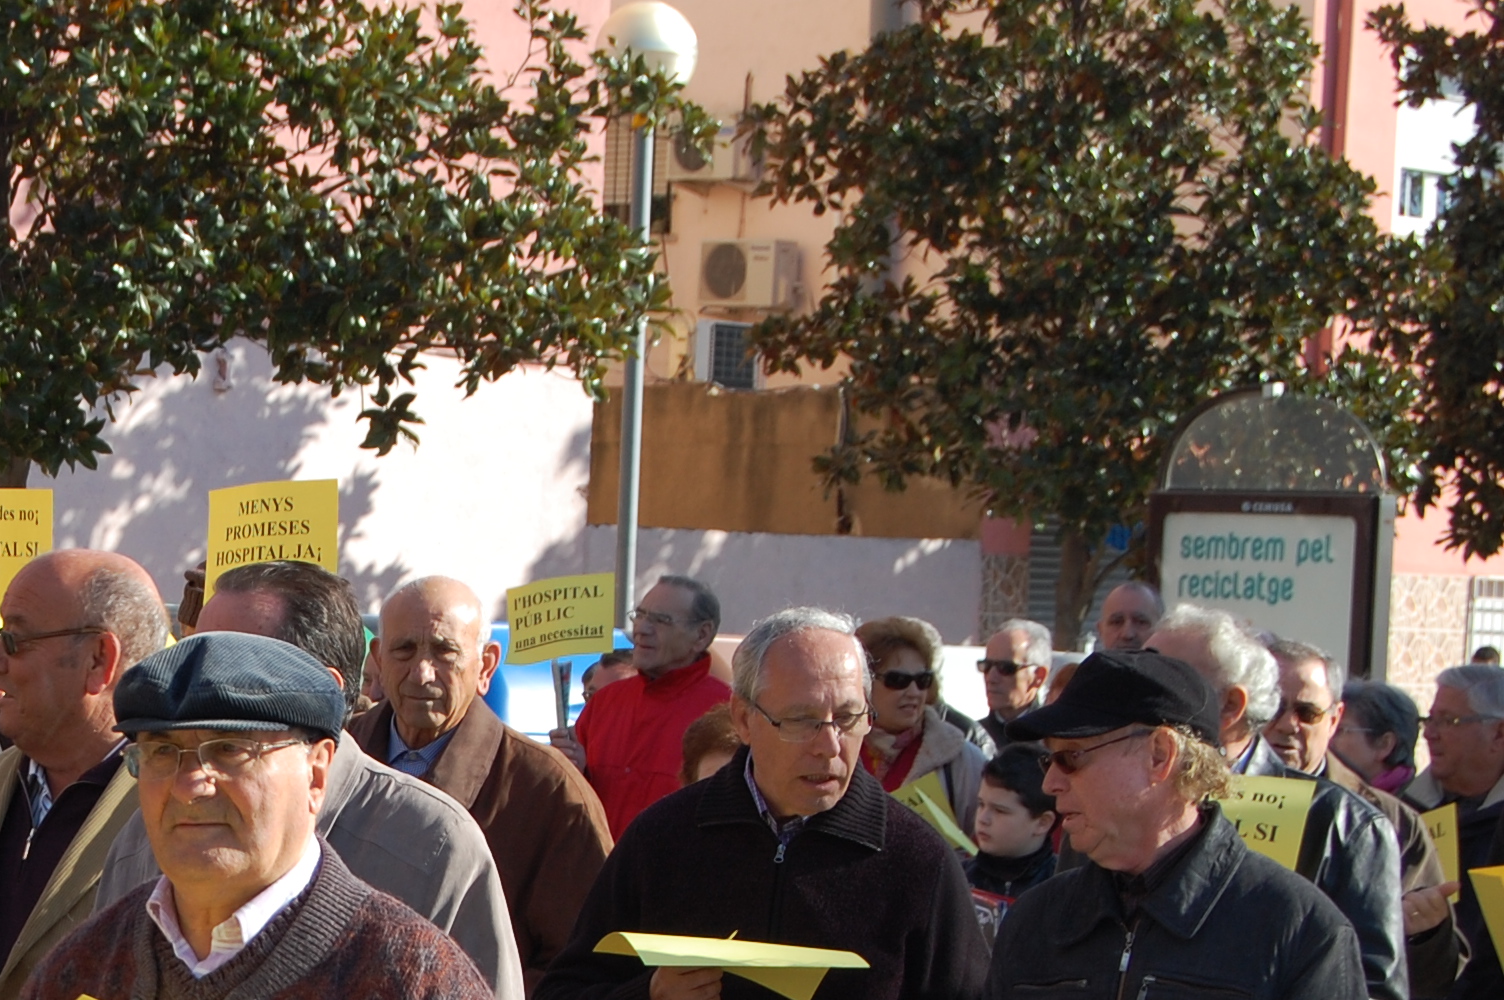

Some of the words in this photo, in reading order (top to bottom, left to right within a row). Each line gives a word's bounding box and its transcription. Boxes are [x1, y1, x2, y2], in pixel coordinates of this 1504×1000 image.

[238, 496, 294, 516] MENYS
[225, 519, 310, 541] PROMESES
[26, 541, 38, 557] SI
[216, 544, 289, 567] HOSPITAL
[1180, 532, 1285, 562] sembrem
[1296, 534, 1334, 567] pel
[514, 585, 604, 611] l'HOSPITAL
[1177, 570, 1294, 606] reciclatge
[515, 635, 536, 649] una
[540, 624, 604, 642] necessitat
[1253, 822, 1279, 842] SI
